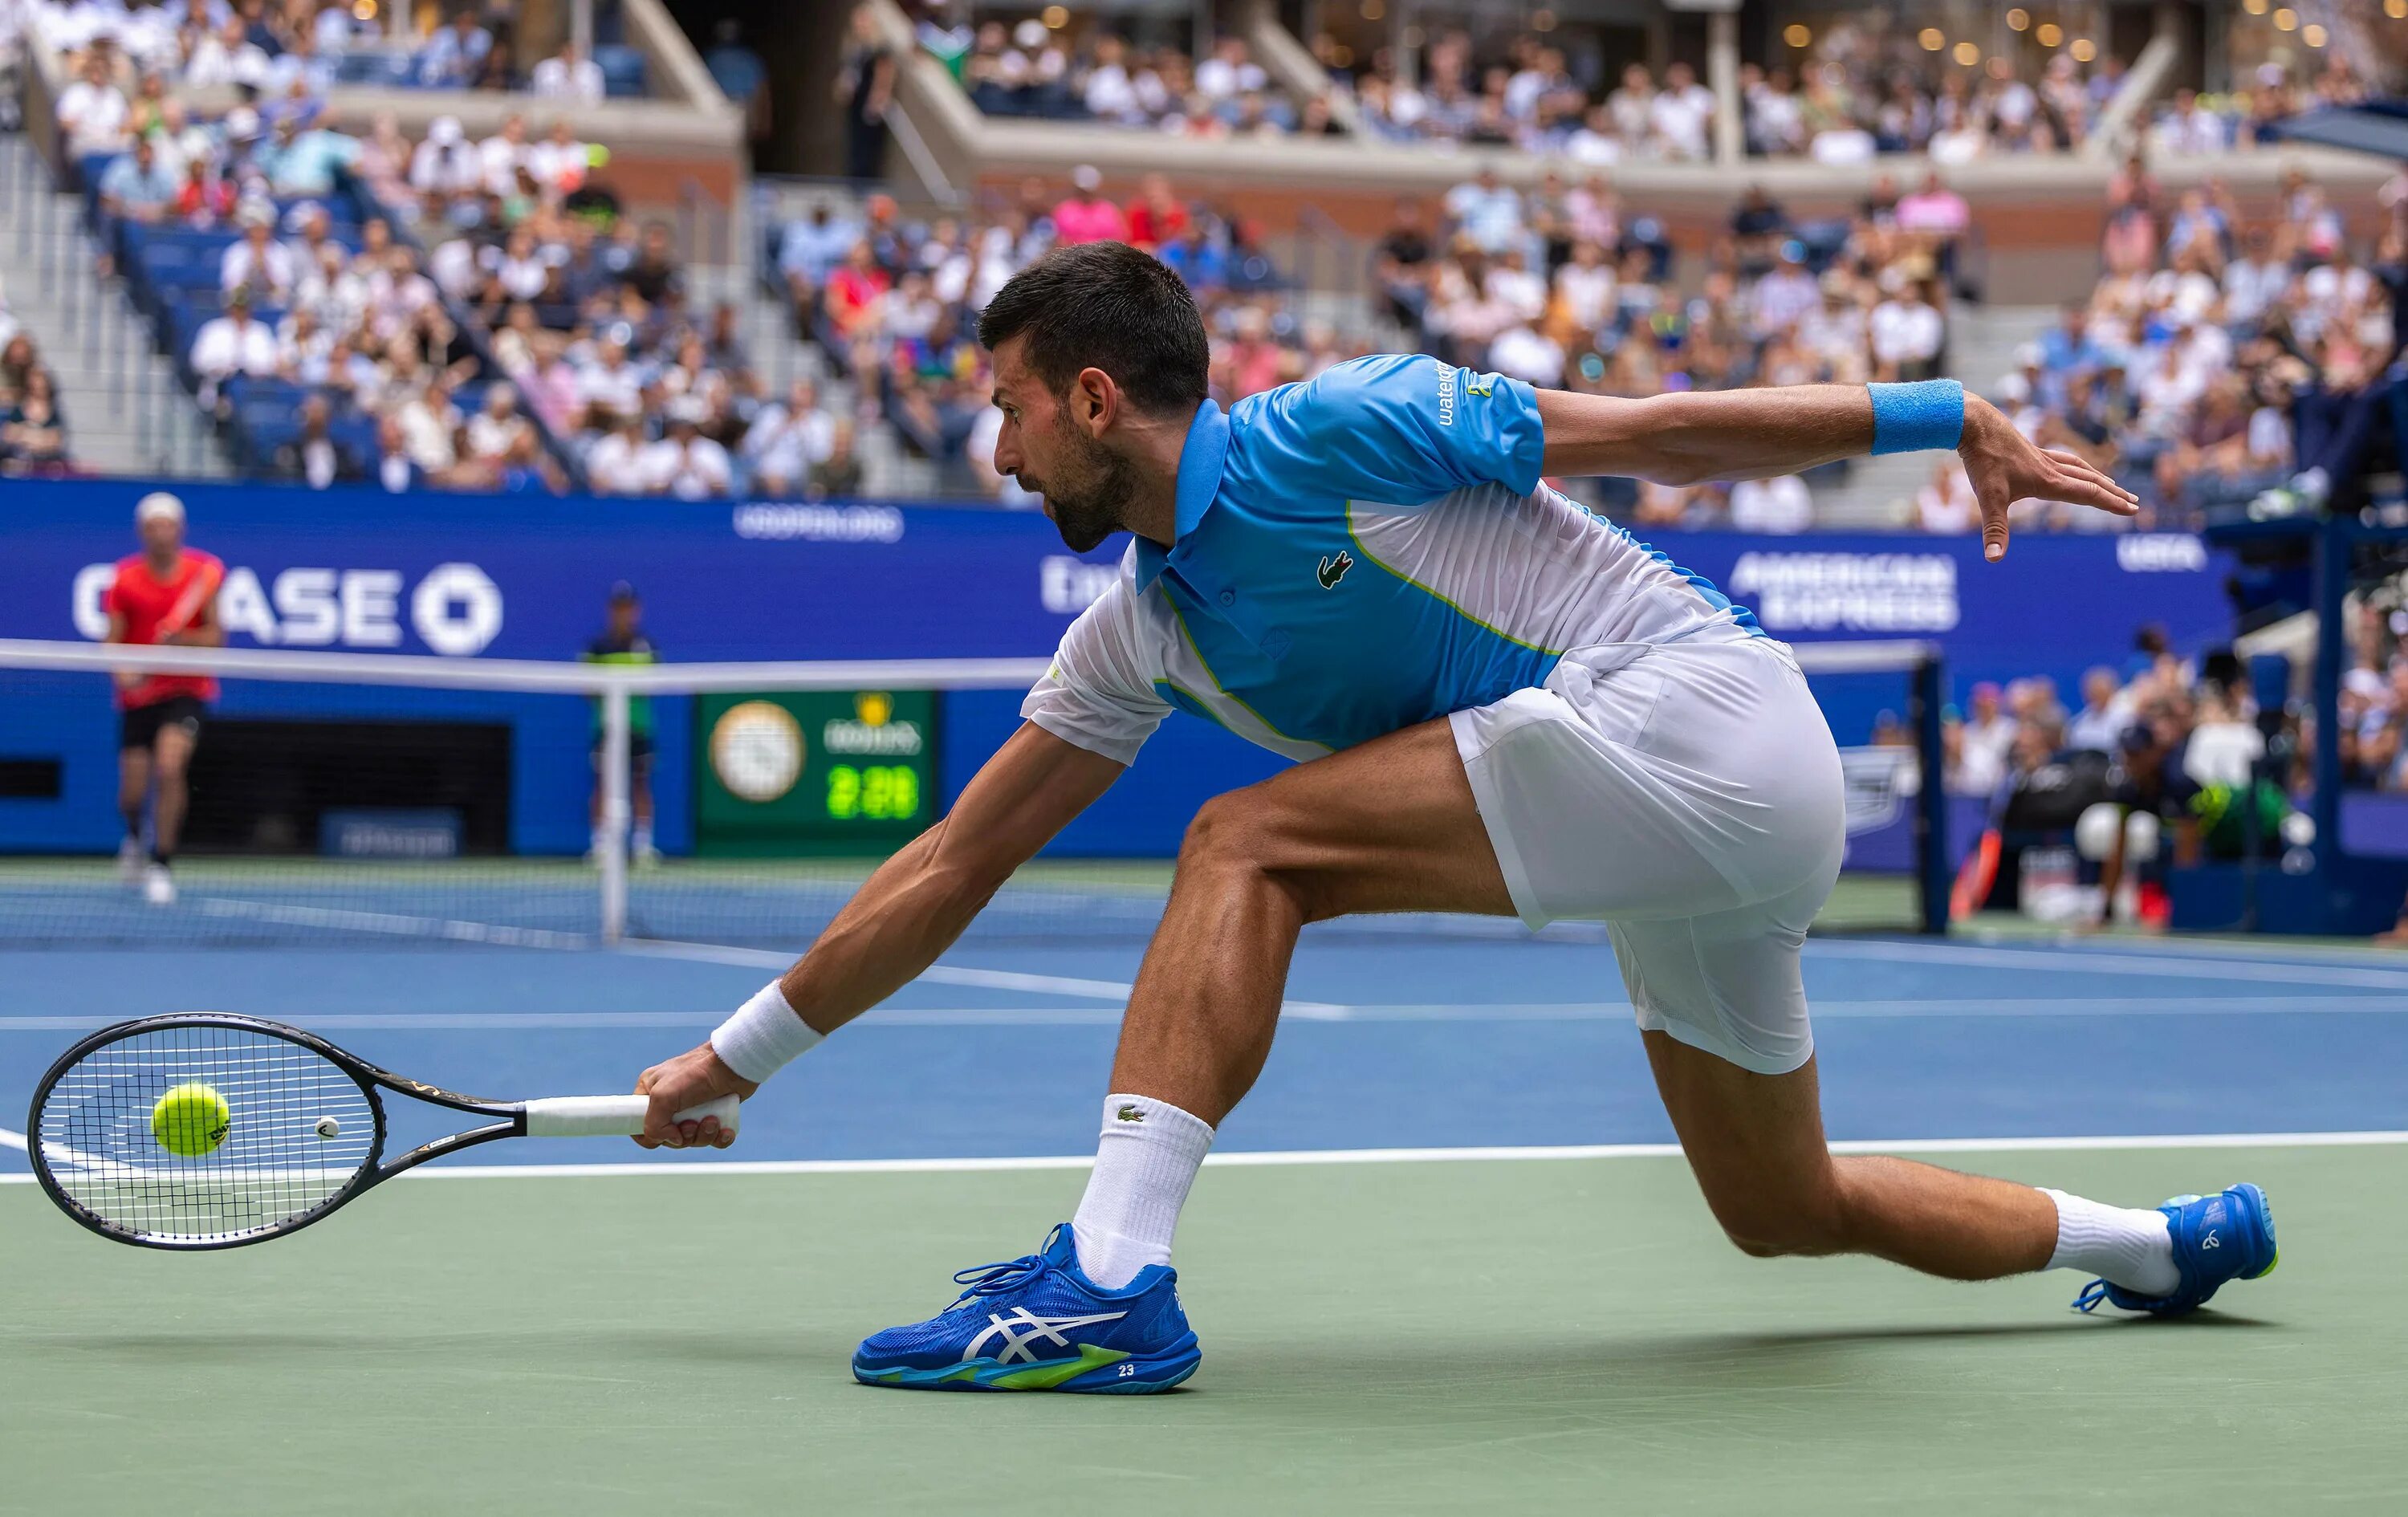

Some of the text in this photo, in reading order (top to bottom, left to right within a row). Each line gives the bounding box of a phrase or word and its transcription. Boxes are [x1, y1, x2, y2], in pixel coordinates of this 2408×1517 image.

[1728, 551, 1958, 594] AMERICAN
[72, 562, 403, 647] CASE
[1759, 591, 1960, 632] EXPRESS
[1118, 1364, 1134, 1377] 23
